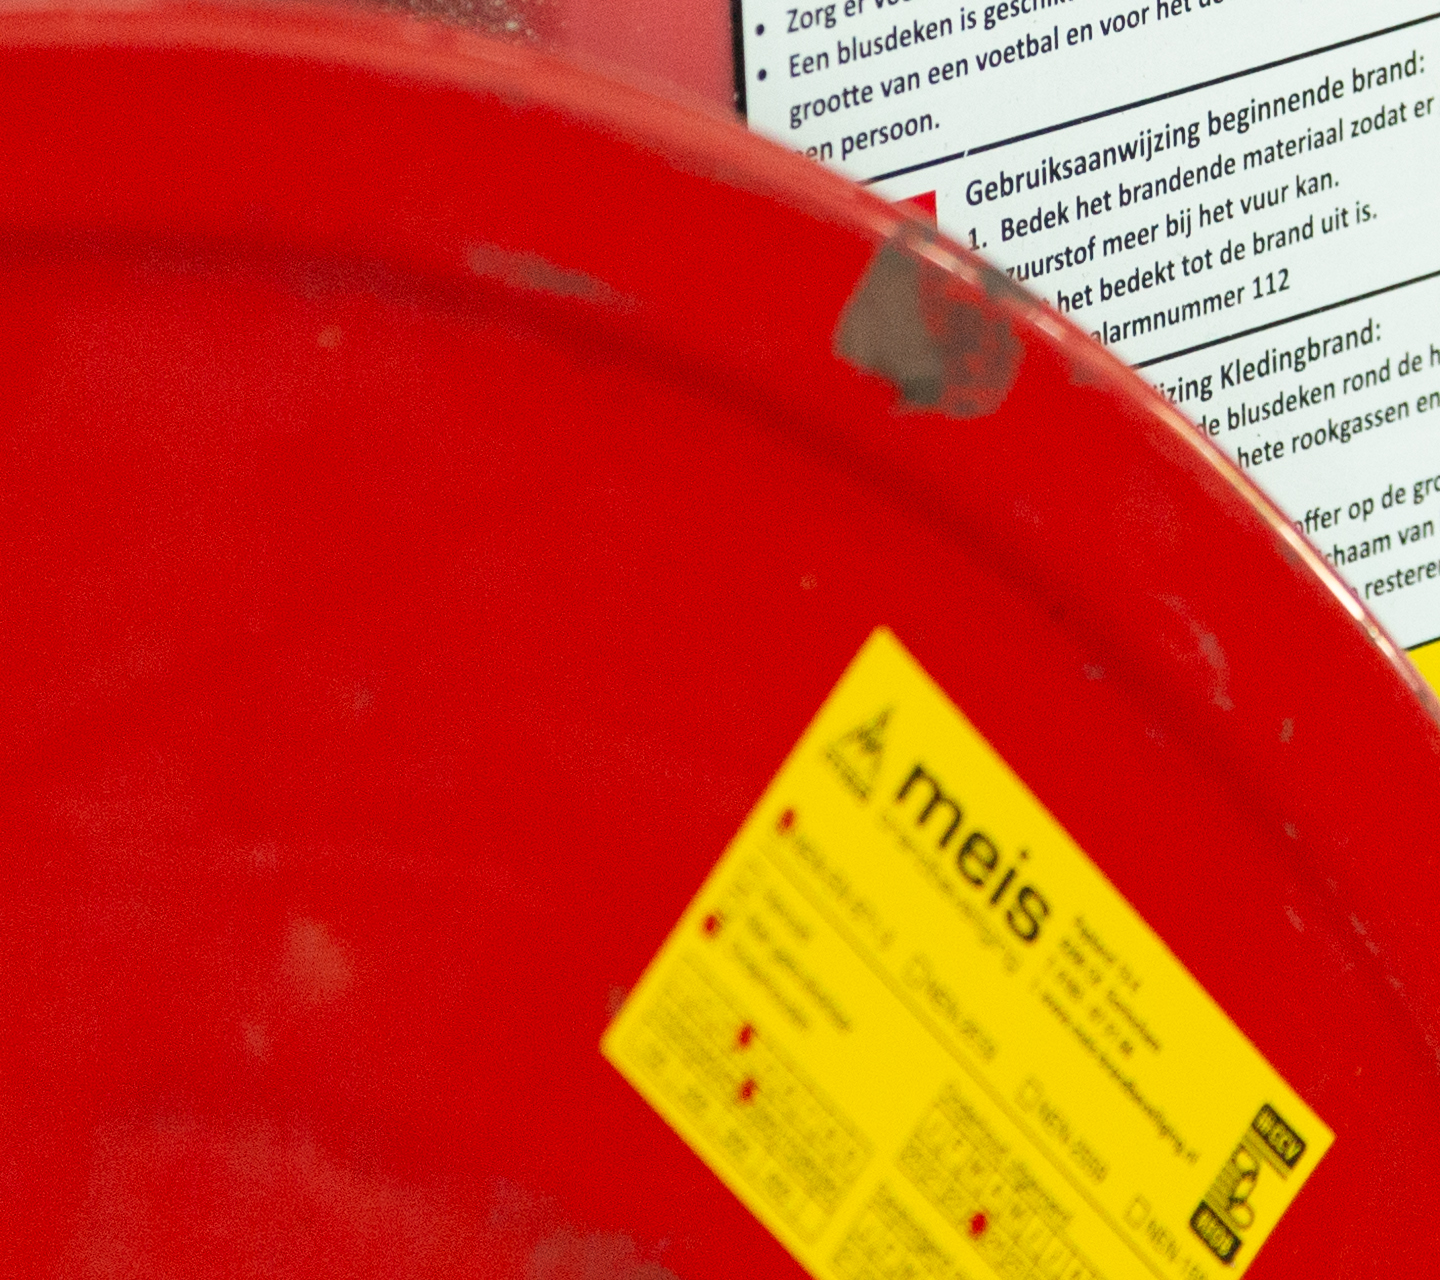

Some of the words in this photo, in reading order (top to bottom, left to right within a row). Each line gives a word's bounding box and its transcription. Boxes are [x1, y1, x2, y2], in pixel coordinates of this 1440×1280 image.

[786, 2, 838, 35] Zorg
[788, 50, 831, 79] Een
[836, 16, 954, 66] blusdeken
[959, 6, 978, 33] is
[789, 83, 874, 131] grootte
[879, 70, 922, 99] van
[927, 57, 970, 86] een
[974, 24, 1060, 73] voetbal
[1065, 22, 1094, 47] en
[1098, 5, 1151, 38] voor
[795, 139, 835, 164] en
[840, 112, 941, 162] persoon.
[964, 120, 1202, 208] Gebruiksaanwijzing
[1206, 74, 1346, 138] beginnende
[1351, 48, 1426, 95] brand:
[967, 226, 988, 253] 1.
[1000, 199, 1071, 243] Bedek
[1075, 189, 1113, 222] het
[1117, 152, 1237, 209] brandende
[1242, 116, 1345, 172] materiaal
[1349, 101, 1408, 140] zodat
[1412, 96, 1436, 120] er
[1101, 222, 1160, 258] meer
[1165, 206, 1193, 240] bij
[1197, 197, 1235, 229] het
[1238, 183, 1290, 216] vuur
[1294, 171, 1340, 200] kan.
[1098, 259, 1177, 304] bedekt
[1180, 247, 1214, 278] tot
[1218, 238, 1246, 267] de
[1251, 213, 1315, 257] brand
[1320, 206, 1350, 236] uit
[1355, 200, 1378, 225] is.
[1252, 266, 1291, 301] 112
[1219, 317, 1382, 391] Kledingbrand:
[1226, 381, 1337, 432] blusdeken
[1342, 356, 1392, 396] rond
[1397, 351, 1424, 378] de
[1290, 400, 1411, 455] rookgassen
[1347, 496, 1375, 523] op
[1380, 483, 1407, 511] de
[1396, 519, 1435, 547] van
[893, 762, 1053, 947] meis
